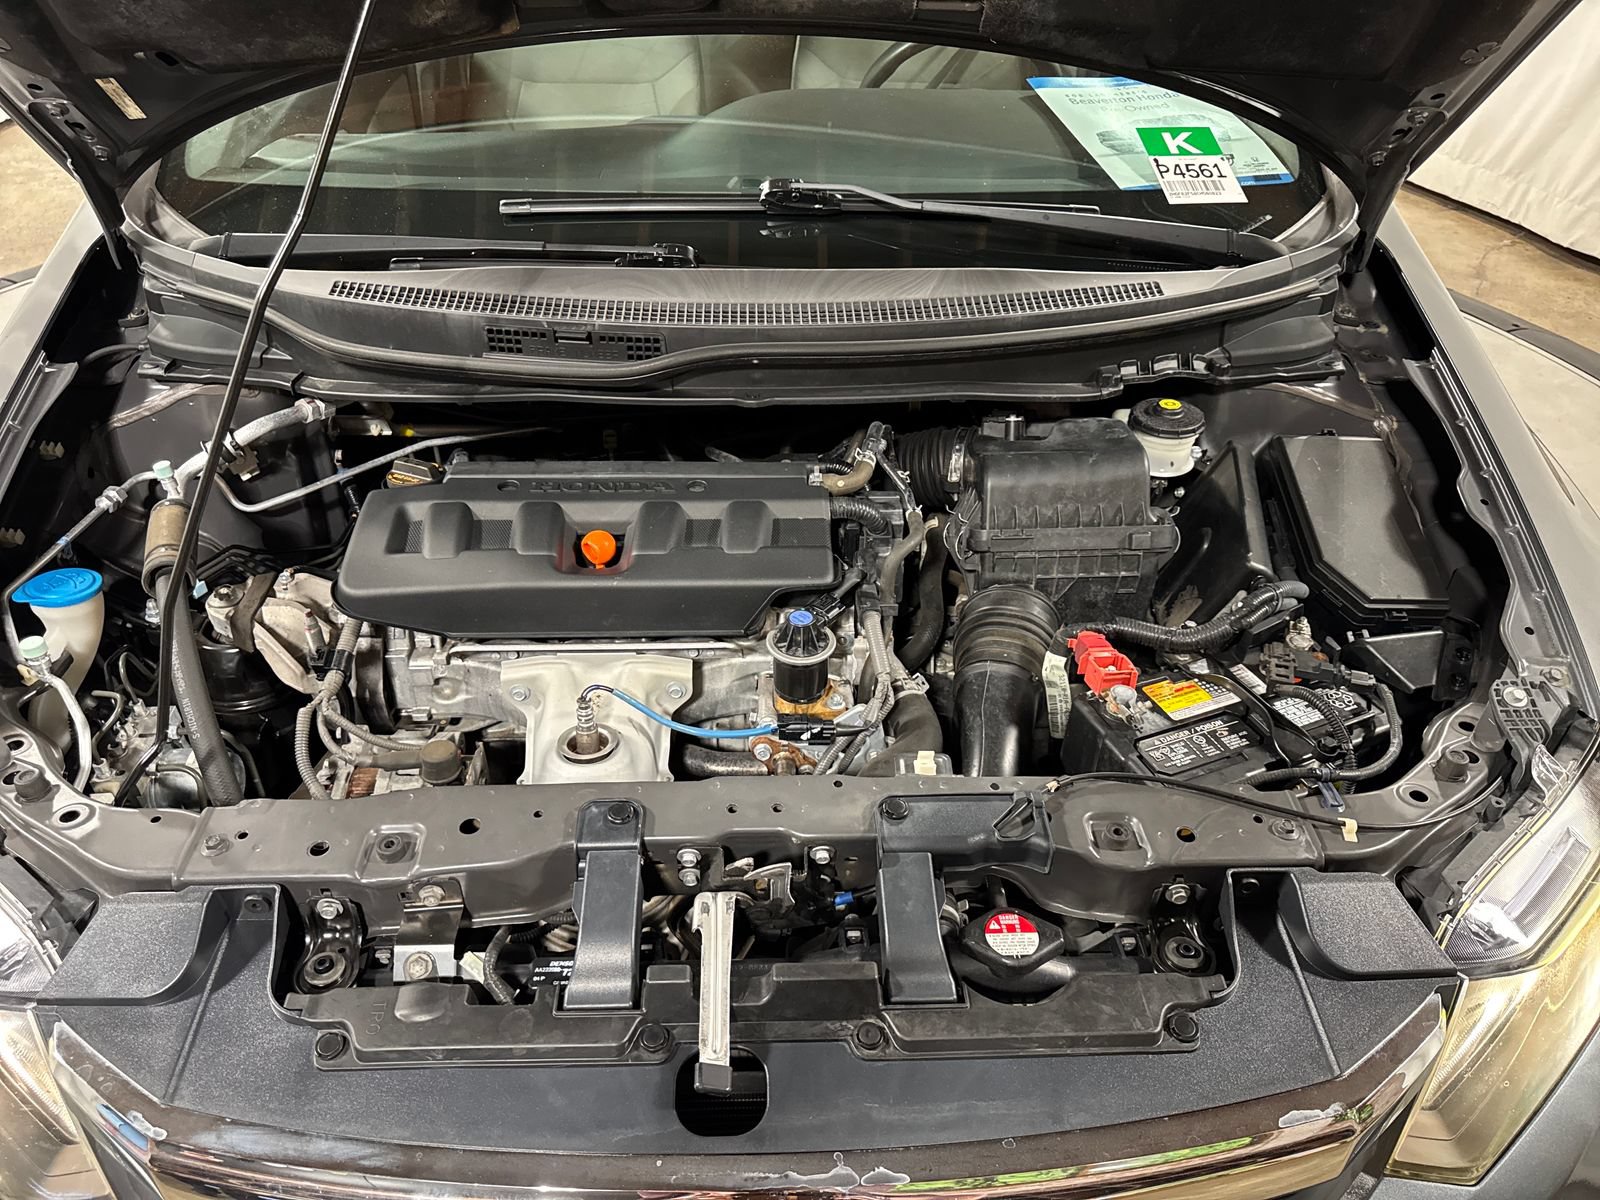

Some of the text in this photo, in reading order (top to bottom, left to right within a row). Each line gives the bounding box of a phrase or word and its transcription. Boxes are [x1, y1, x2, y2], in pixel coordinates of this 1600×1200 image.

[1136, 91, 1181, 102] Honda
[1161, 131, 1203, 154] K
[1156, 163, 1228, 179] P4561
[529, 479, 678, 494] HONDA
[1160, 729, 1191, 744] DANGER
[1196, 719, 1225, 733] POISON
